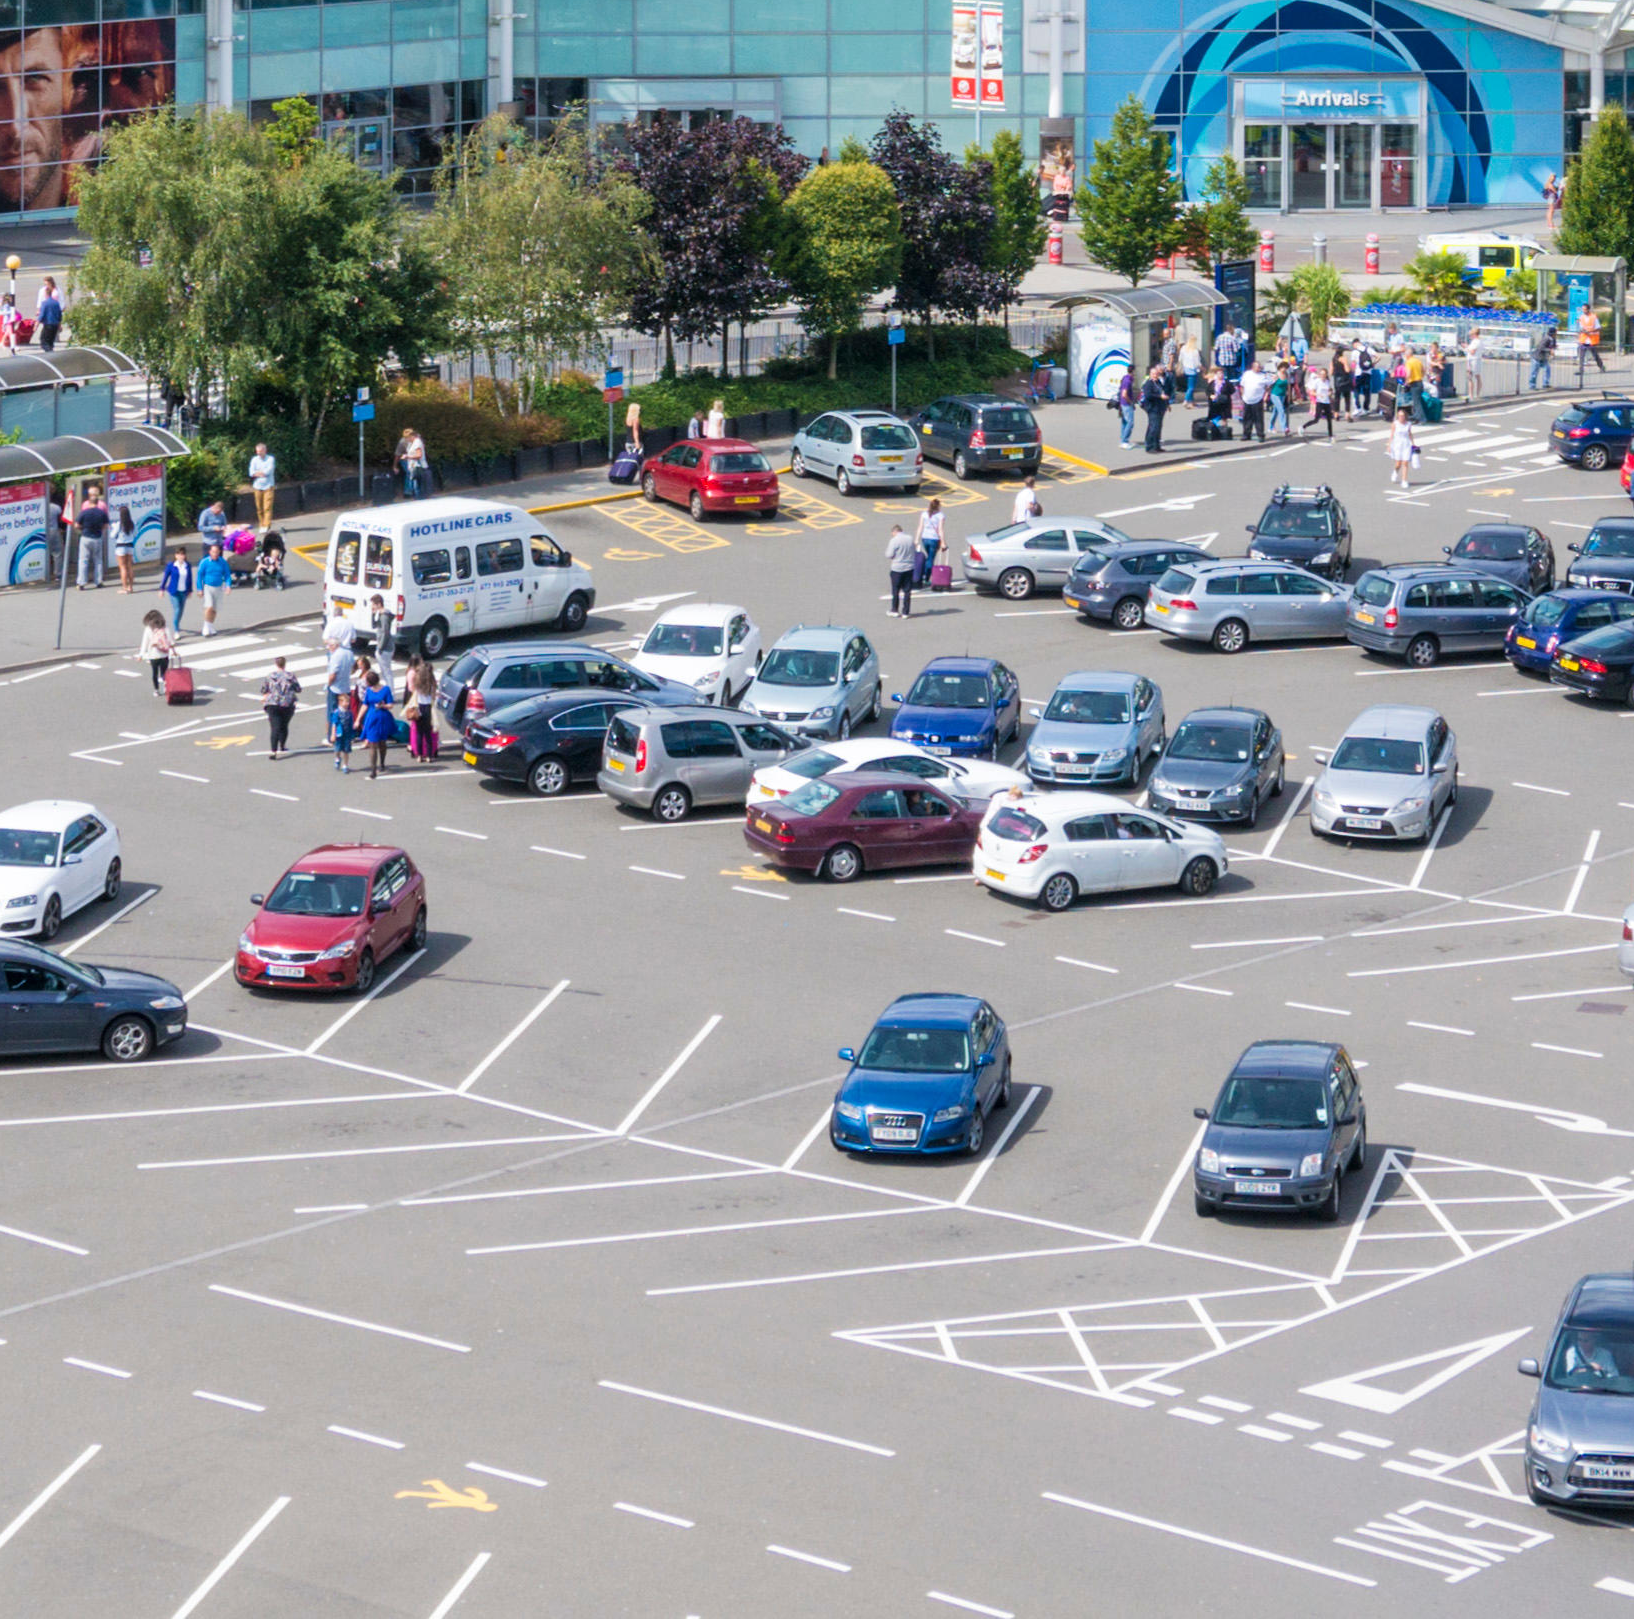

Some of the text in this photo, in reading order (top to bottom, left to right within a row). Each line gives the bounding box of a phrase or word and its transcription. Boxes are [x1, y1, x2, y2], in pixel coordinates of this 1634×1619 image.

[1296, 90, 1370, 107] Arrivals
[109, 483, 157, 498] Please pay
[24, 502, 41, 513] pay
[132, 495, 161, 507] before
[14, 515, 44, 527] before
[410, 512, 513, 538] HOTLINE CARS
[1332, 1499, 1555, 1584] EXIT
